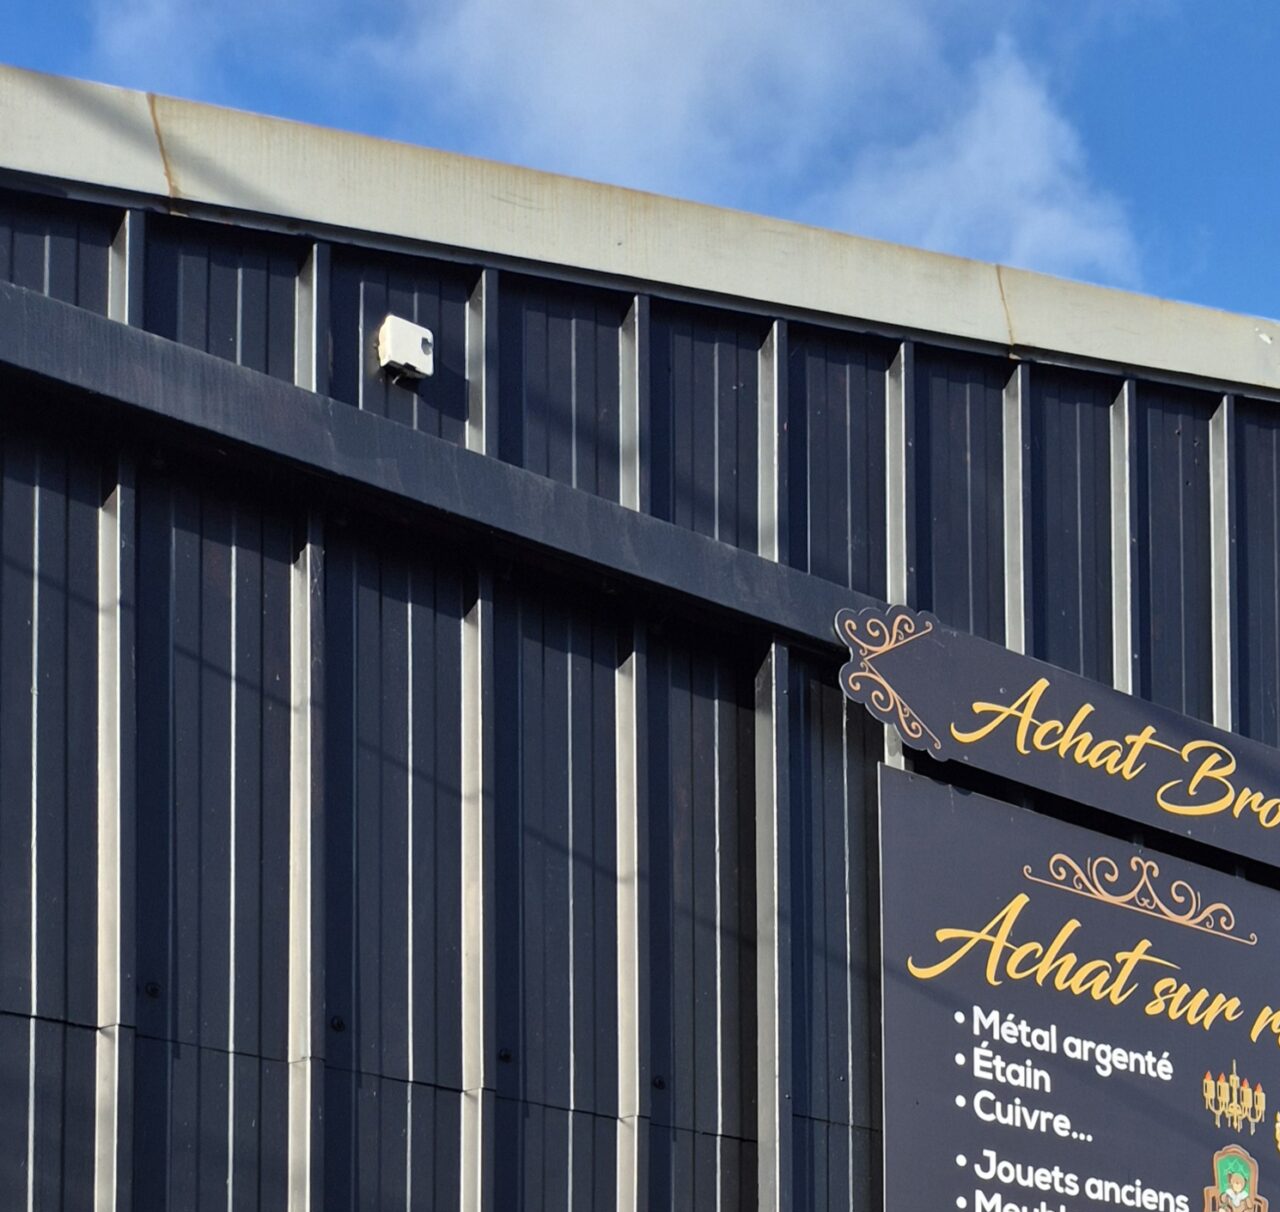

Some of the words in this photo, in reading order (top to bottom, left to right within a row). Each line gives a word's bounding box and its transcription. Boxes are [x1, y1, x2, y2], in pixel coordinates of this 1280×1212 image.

[951, 678, 1180, 780] Achat
[907, 894, 1180, 1004] Achat
[1146, 977, 1243, 1030] sur
[973, 1005, 1057, 1054] Métal
[1063, 1036, 1174, 1080] argenté
[973, 1041, 1051, 1093] Étain
[973, 1089, 1093, 1142] Cuivre...
[974, 1149, 1079, 1196] Jouets
